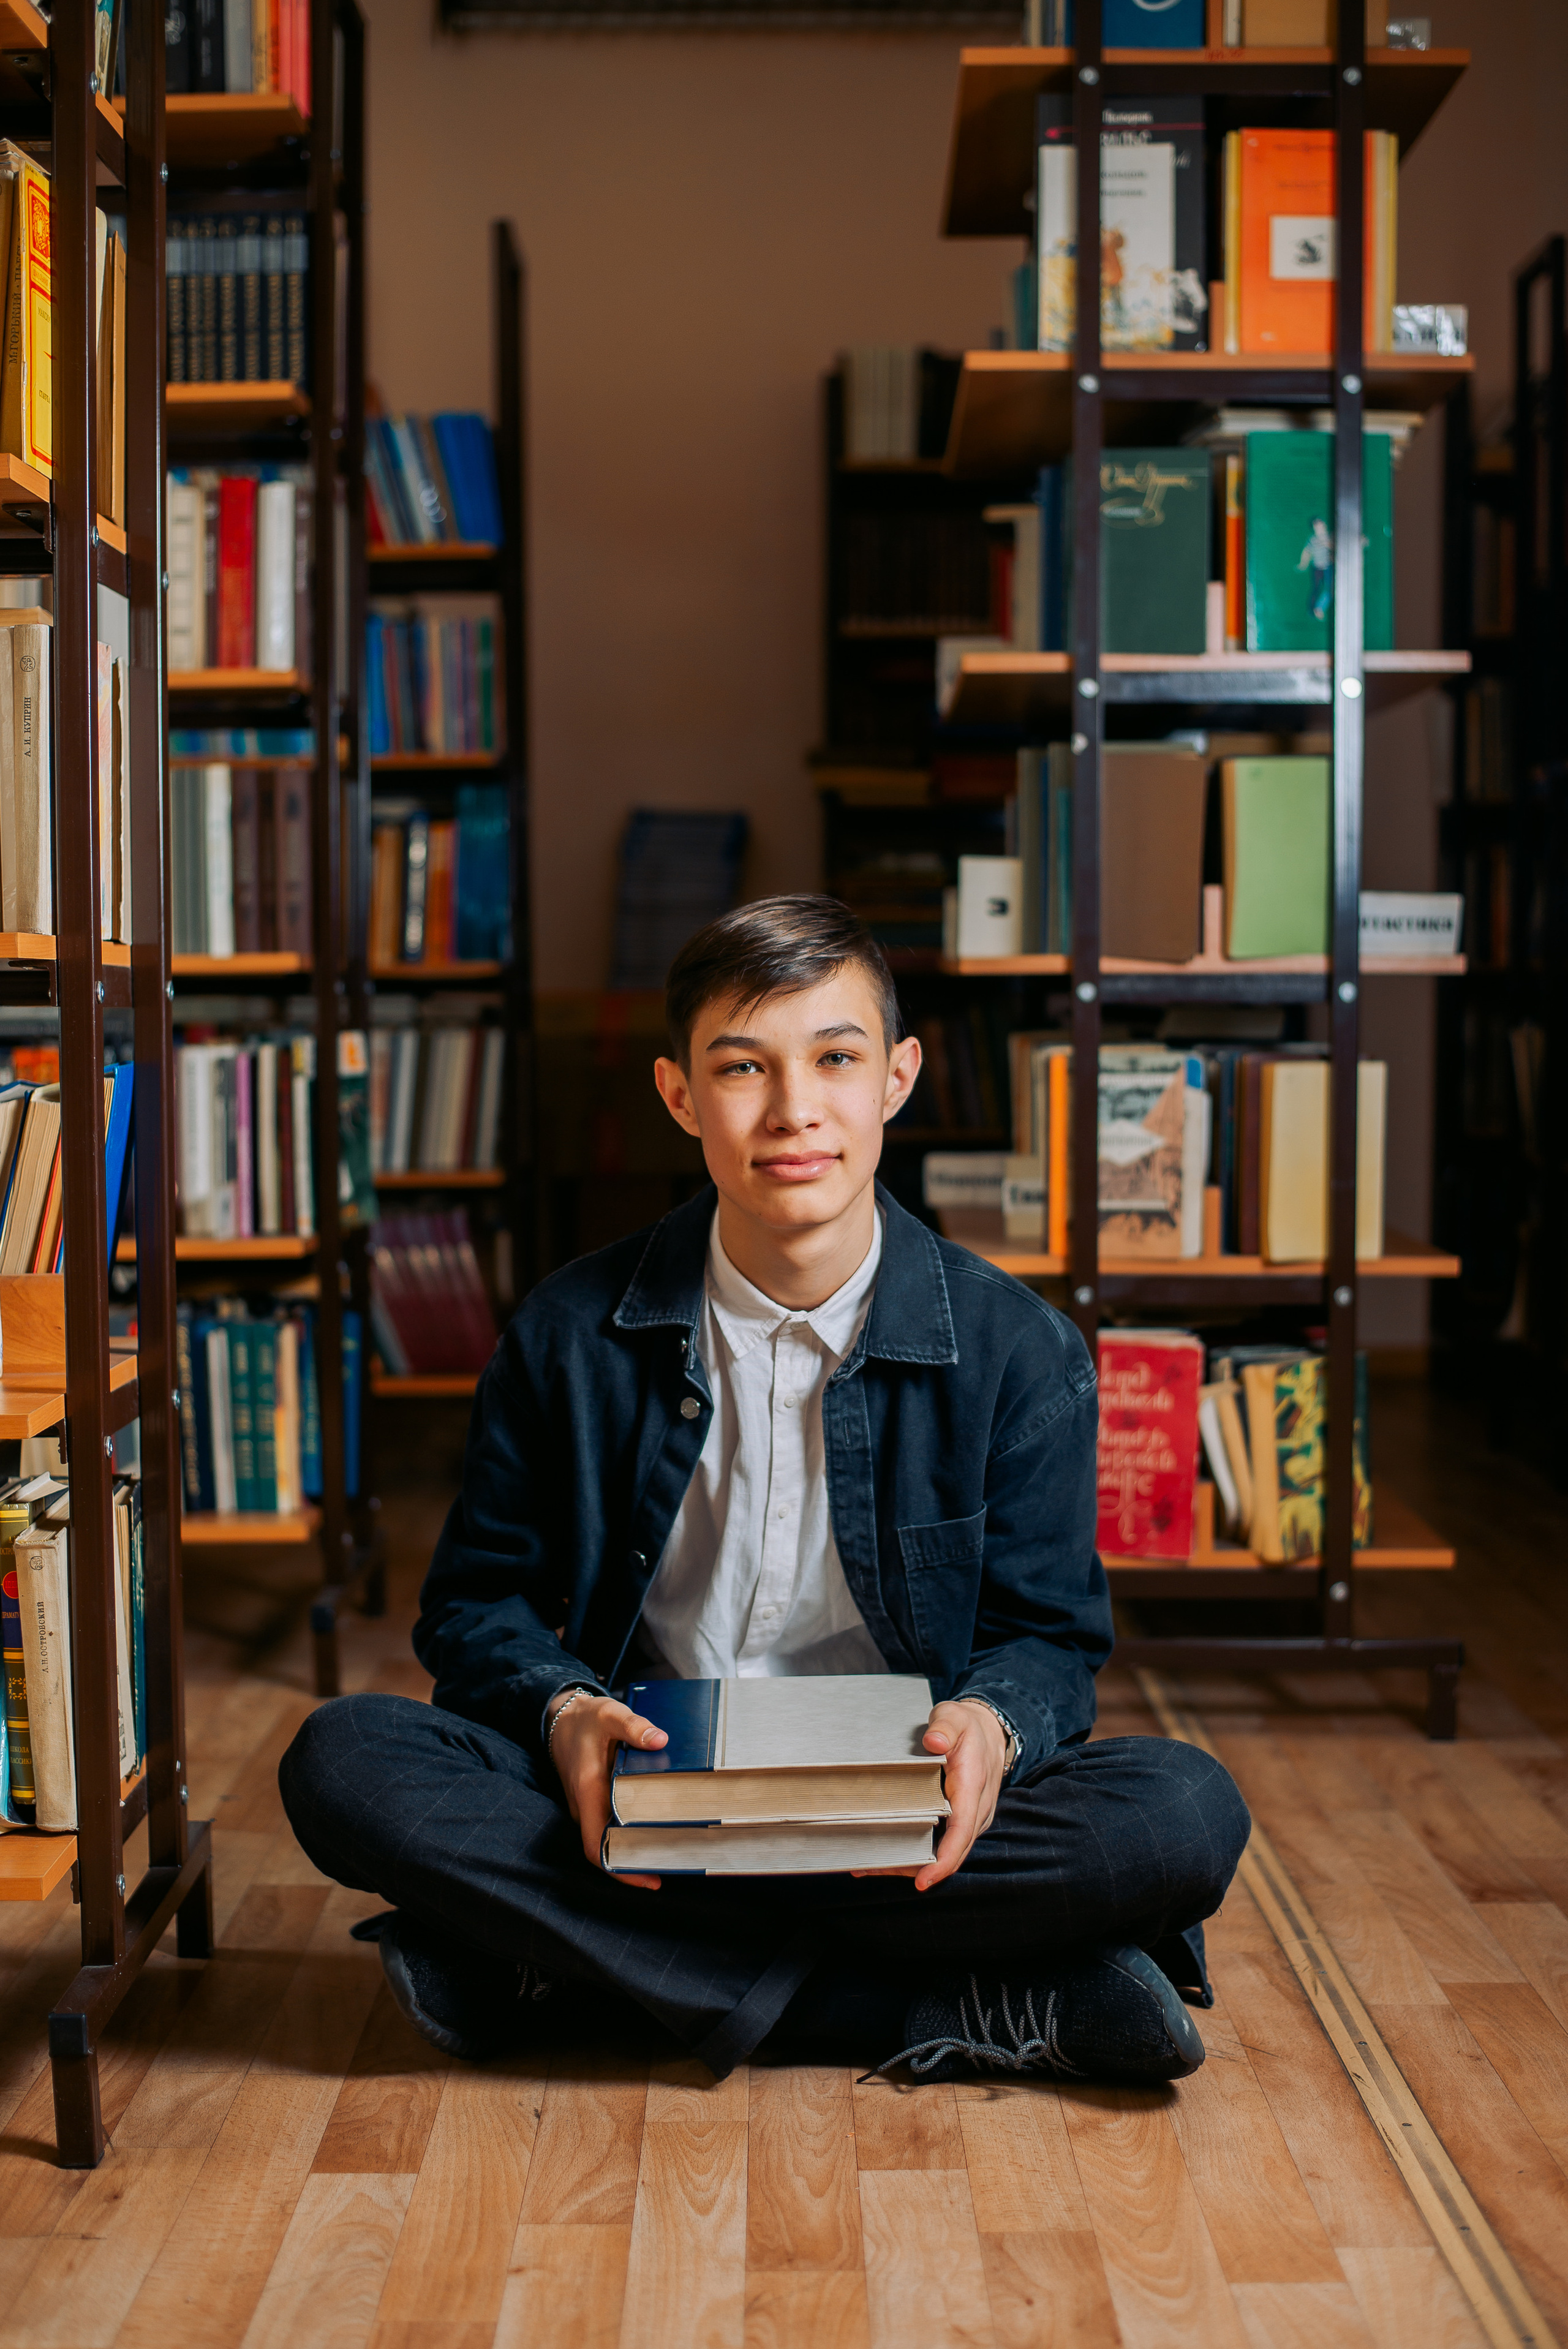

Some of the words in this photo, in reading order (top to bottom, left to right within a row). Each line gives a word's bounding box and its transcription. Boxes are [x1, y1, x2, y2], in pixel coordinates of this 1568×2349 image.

[24, 736, 31, 745] И.
[24, 748, 31, 757] А.
[36, 1601, 48, 1656] ОСТРОВСКИЙ
